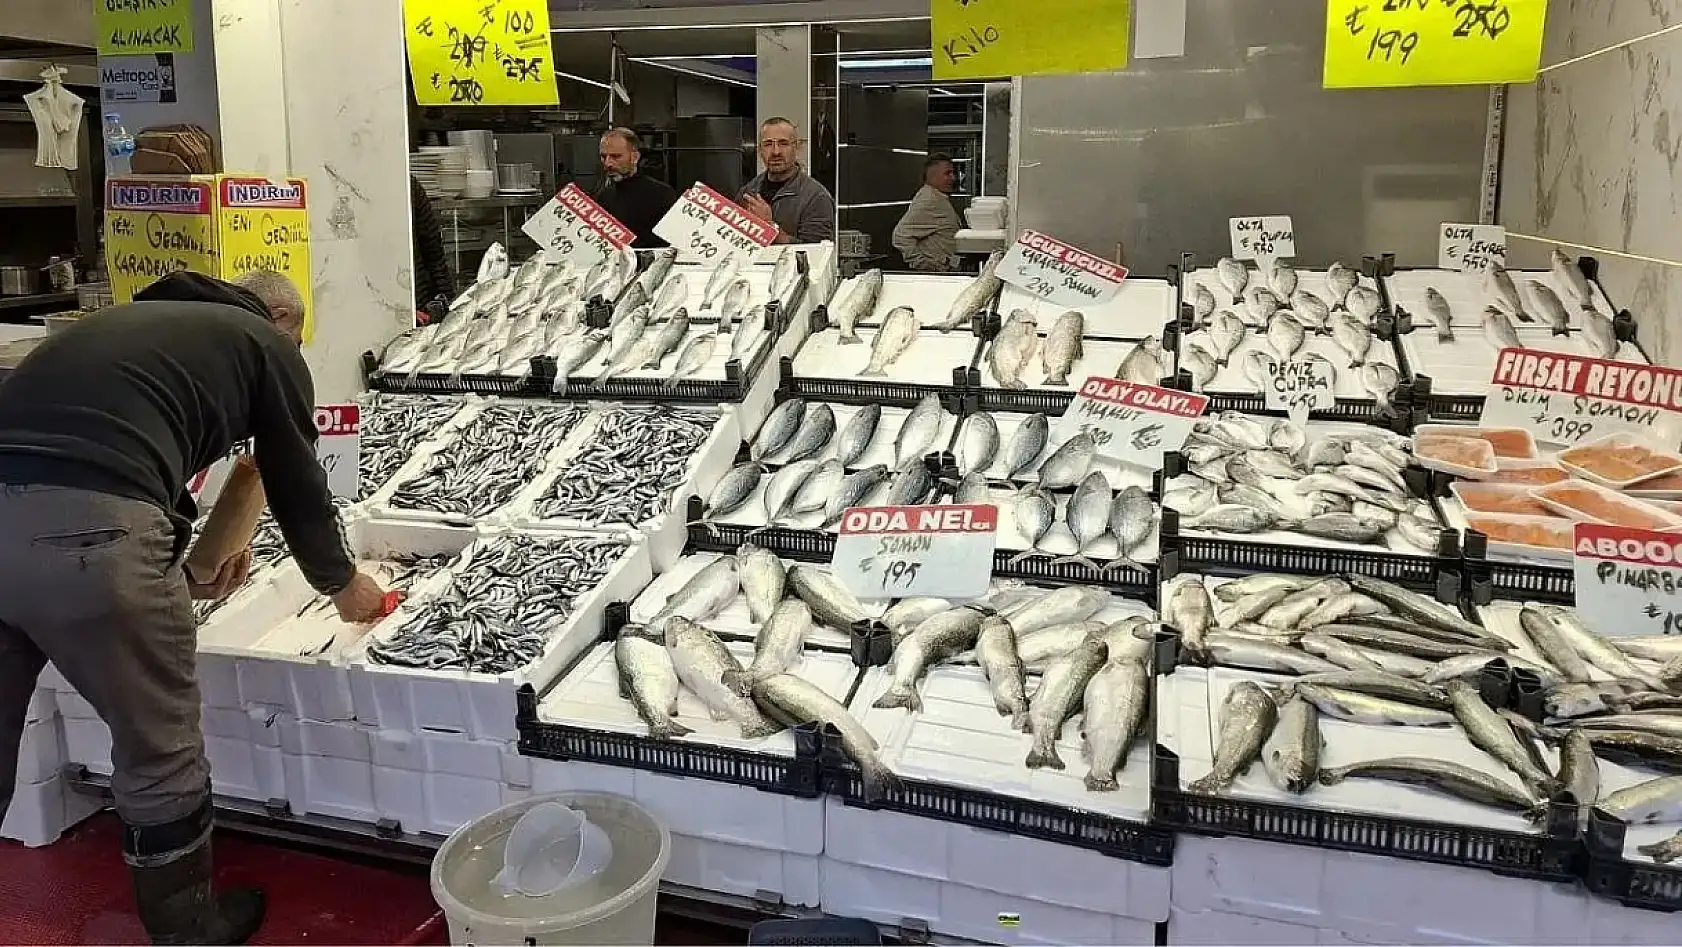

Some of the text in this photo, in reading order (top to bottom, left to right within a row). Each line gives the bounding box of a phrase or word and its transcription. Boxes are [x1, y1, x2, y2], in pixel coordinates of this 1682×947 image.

[505, 10, 533, 34] 100
[942, 26, 999, 65] Kilo
[1367, 28, 1419, 65] 199
[102, 68, 158, 84] Metropol
[1237, 218, 1263, 232] OLTA
[1445, 227, 1473, 241] OLTA
[1497, 352, 1582, 392] FIRSAT
[1084, 380, 1133, 404] OLAY
[1551, 417, 1592, 442] 399
[846, 511, 908, 531] ODA
[882, 560, 923, 590] 195
